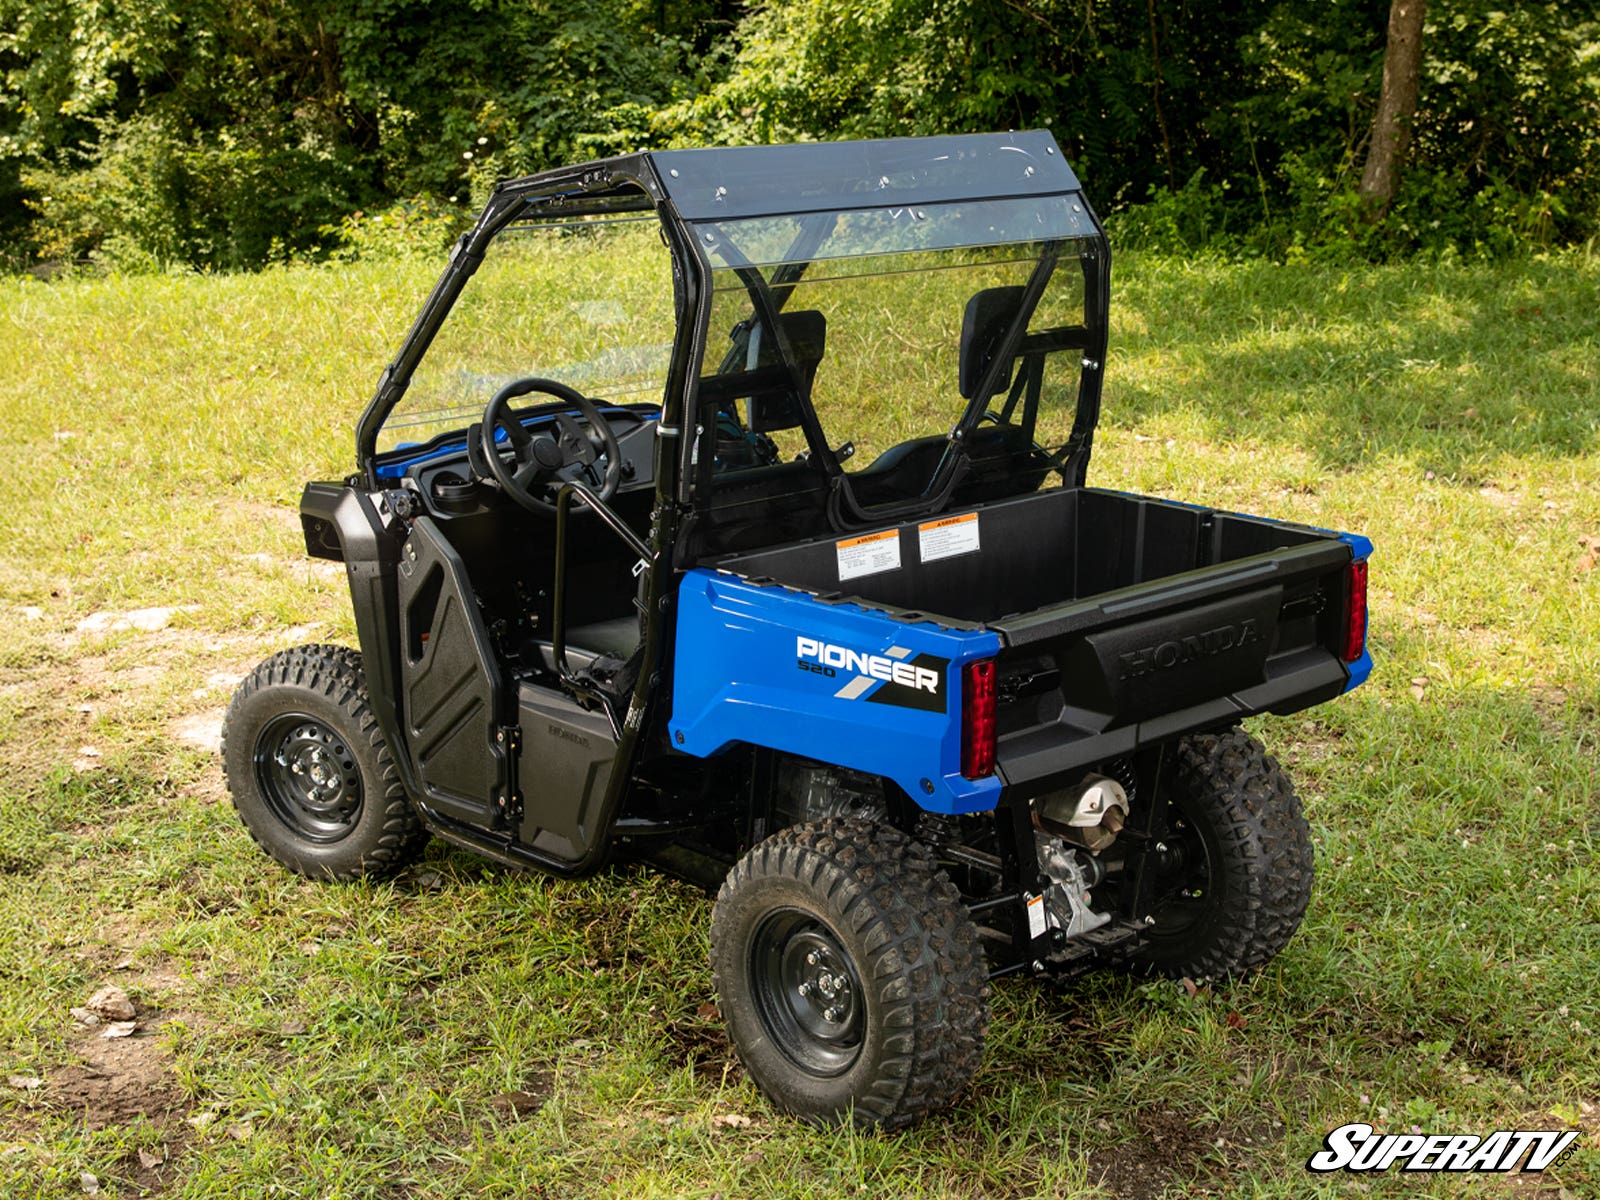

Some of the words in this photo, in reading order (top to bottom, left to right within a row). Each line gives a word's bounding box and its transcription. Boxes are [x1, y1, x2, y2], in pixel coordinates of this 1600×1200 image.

[796, 635, 939, 694] PIONEER
[797, 659, 836, 678] 520
[1119, 618, 1266, 681] HONDA
